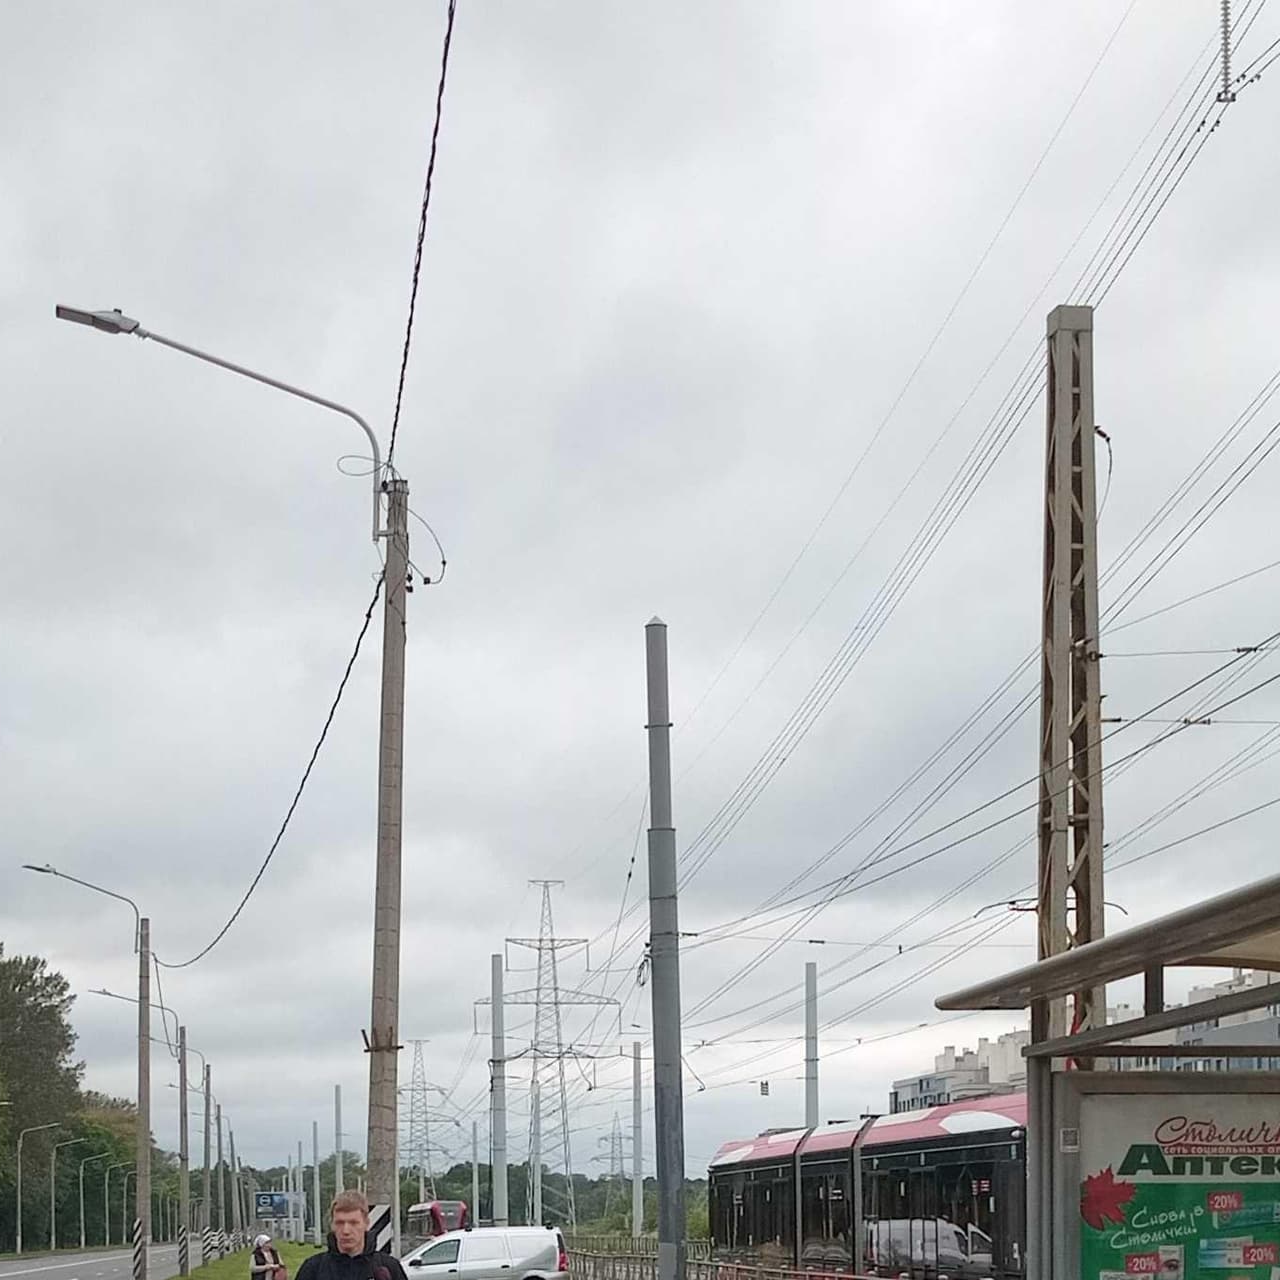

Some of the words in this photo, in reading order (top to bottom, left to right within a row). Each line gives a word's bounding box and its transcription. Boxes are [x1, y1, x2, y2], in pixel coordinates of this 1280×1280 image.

[1191, 1146, 1265, 1155] социальных
[1209, 1193, 1238, 1209] -20%
[1245, 1248, 1274, 1263] -20%
[1128, 1256, 1157, 1271] -20%
